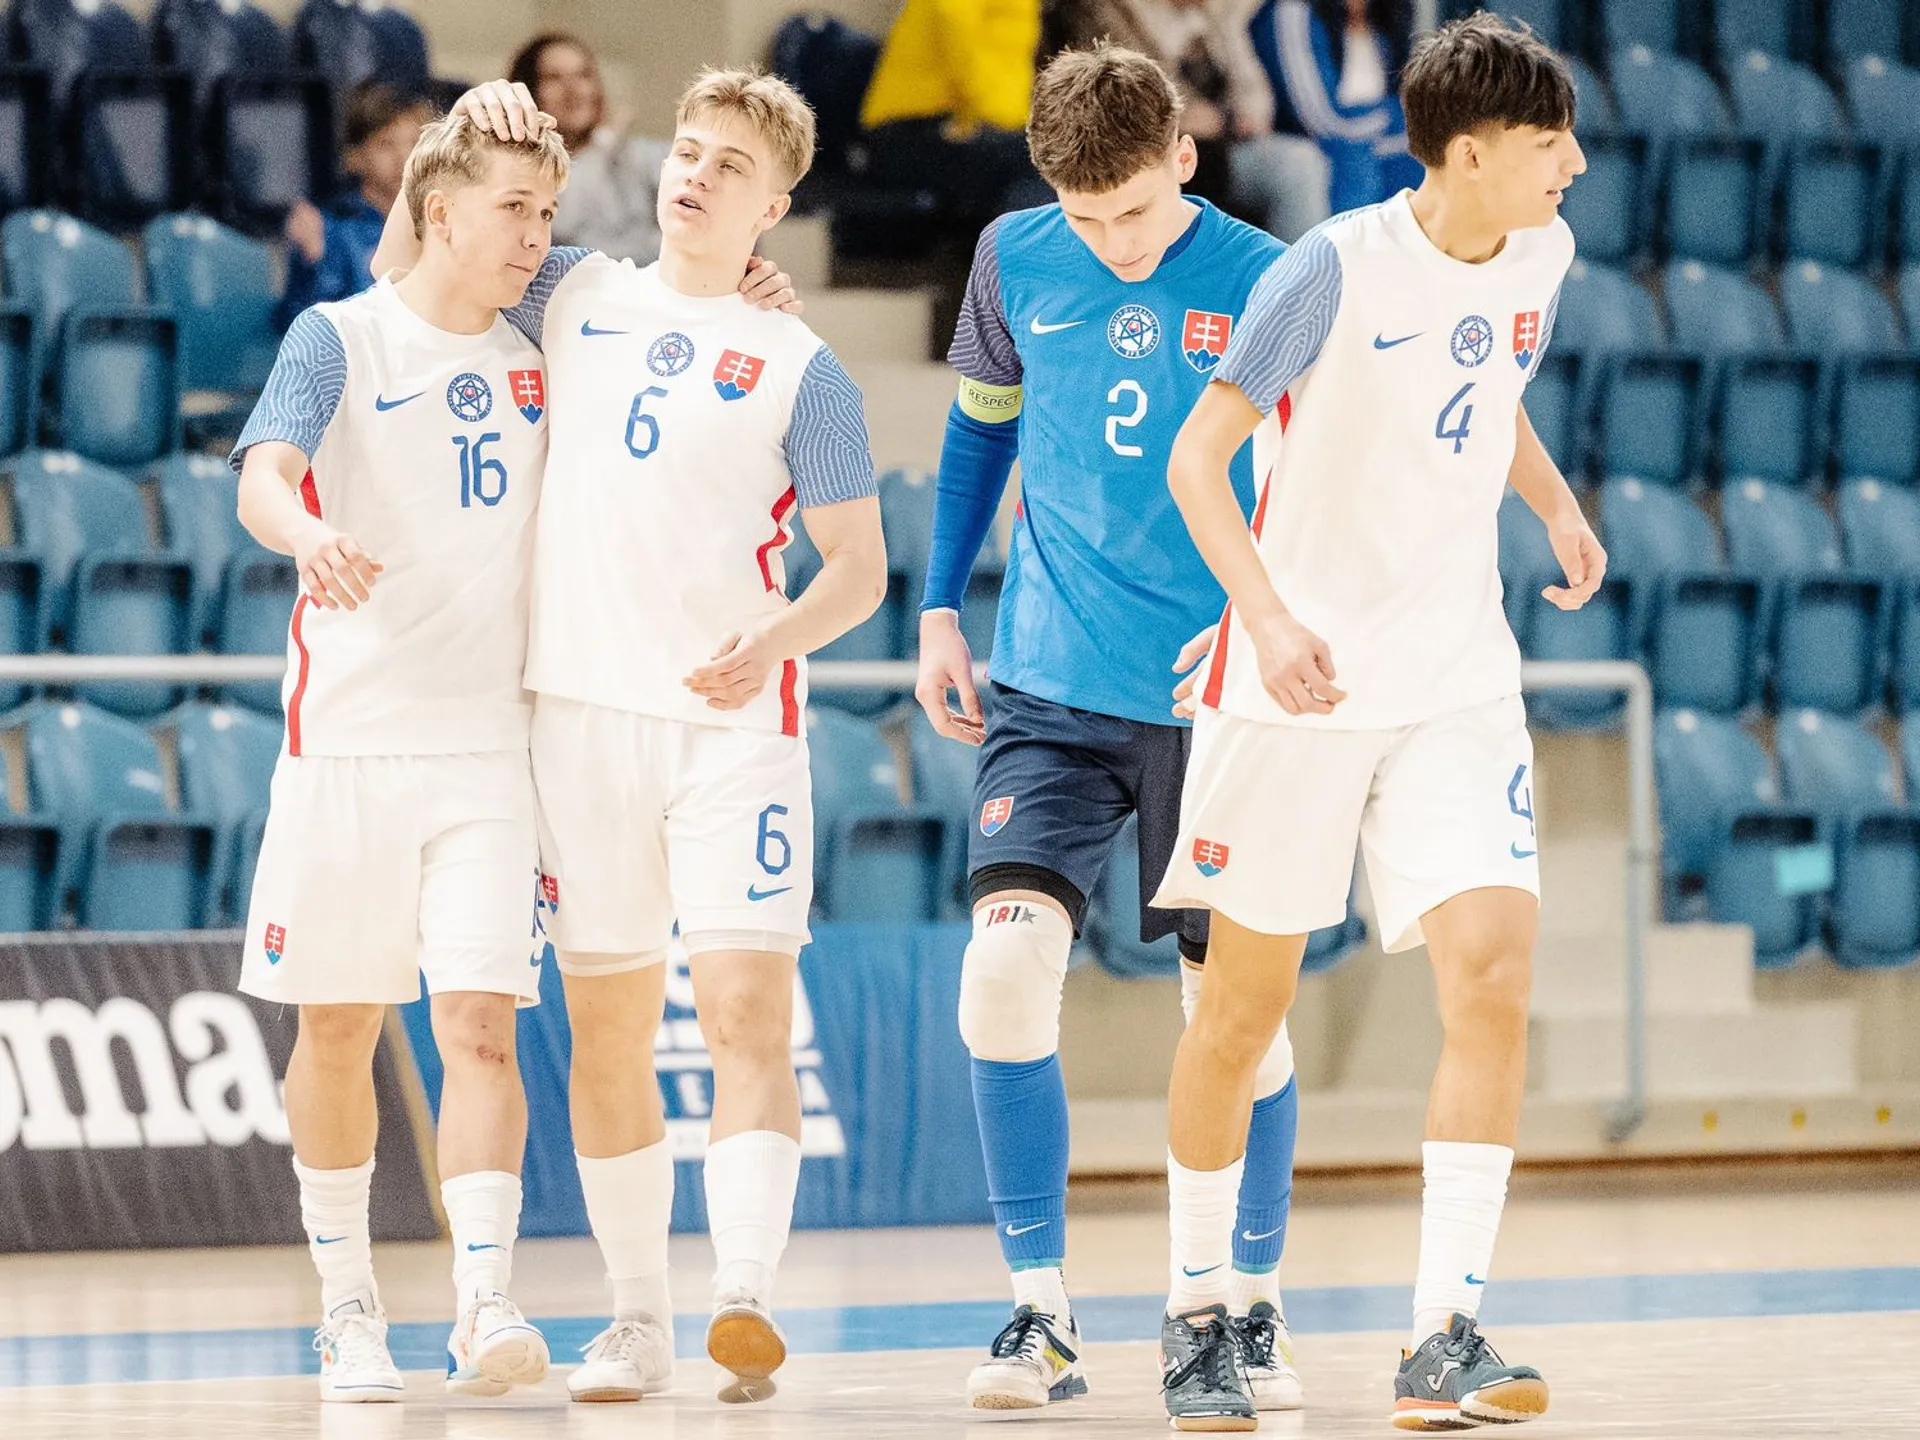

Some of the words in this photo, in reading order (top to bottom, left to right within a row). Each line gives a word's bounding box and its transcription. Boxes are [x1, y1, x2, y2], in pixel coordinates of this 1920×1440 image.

[624, 385, 669, 460] 6
[968, 388, 1020, 407] RESPECT
[1105, 379, 1148, 457] 2
[1435, 382, 1476, 454] 4
[451, 432, 507, 508] 16
[756, 803, 792, 876] 6
[0, 990, 293, 1149] ma
